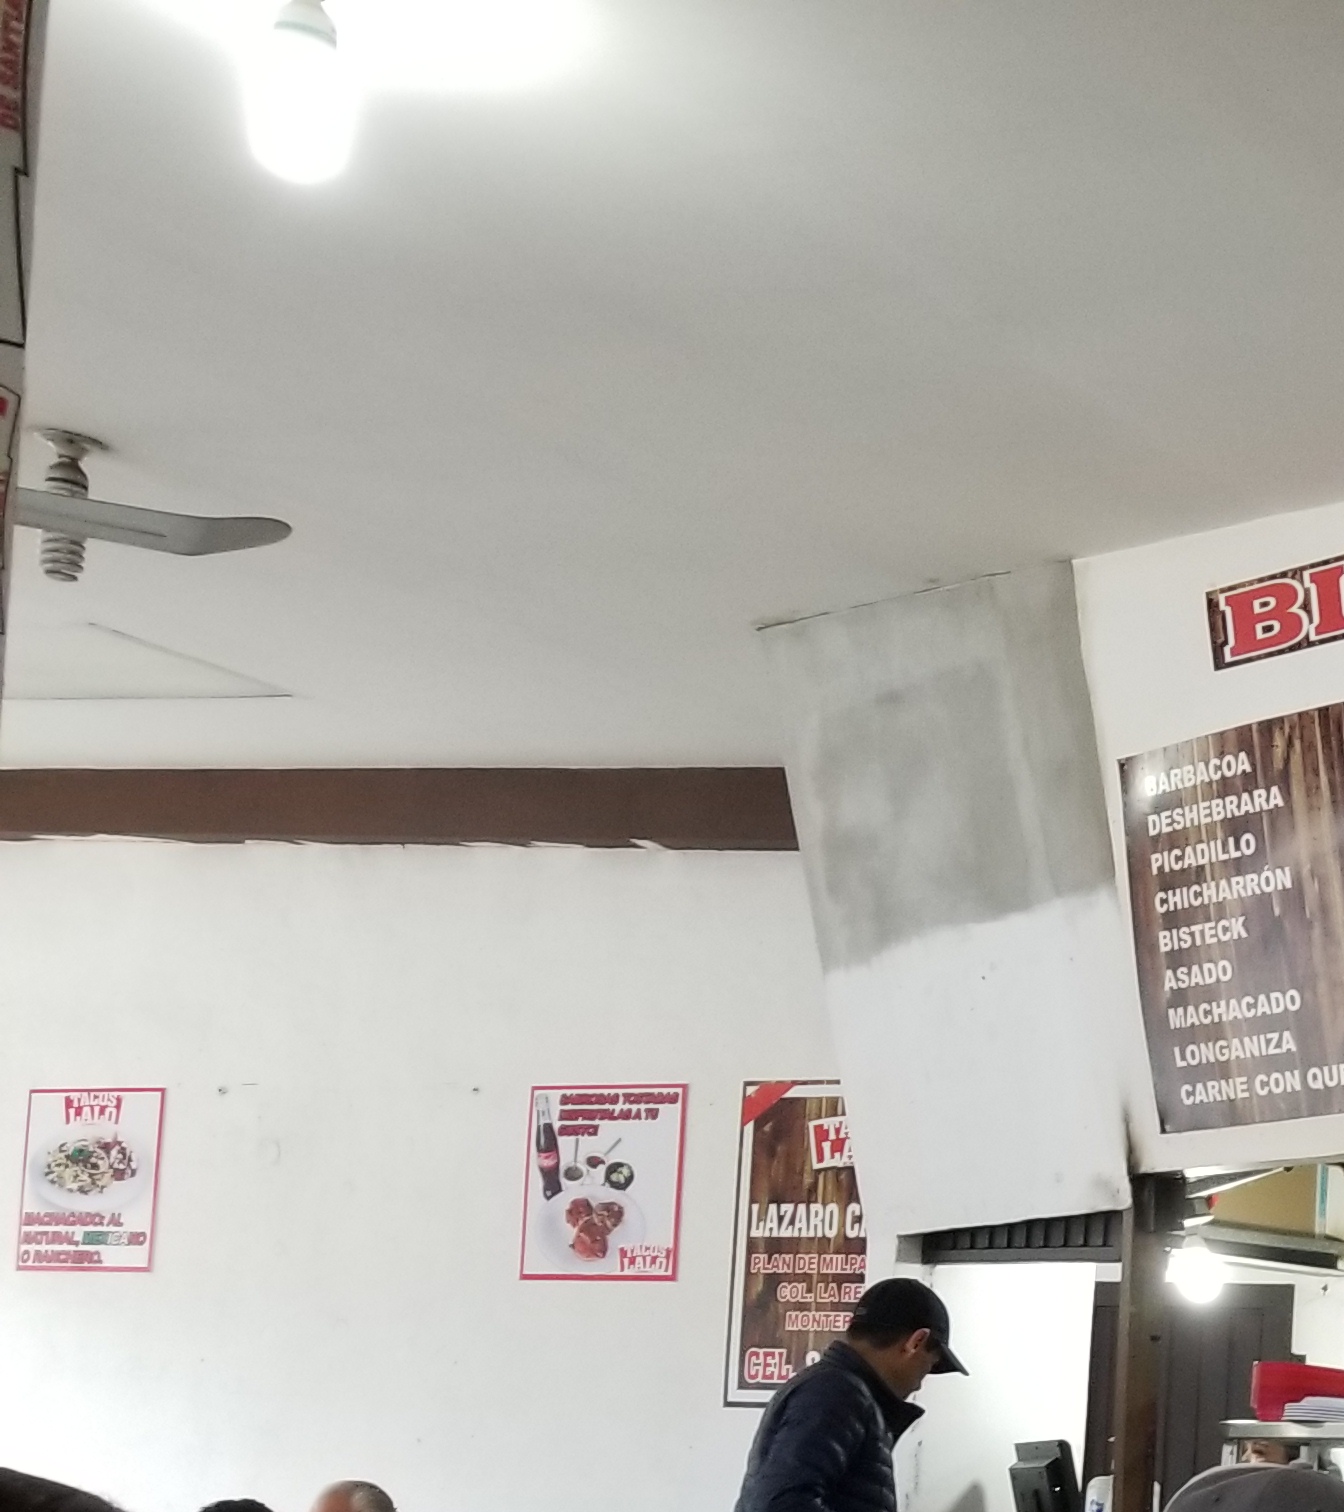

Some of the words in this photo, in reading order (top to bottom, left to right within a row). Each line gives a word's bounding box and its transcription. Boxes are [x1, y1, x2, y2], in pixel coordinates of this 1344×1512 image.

[1147, 786, 1284, 836] DESHEBRARA
[1150, 832, 1256, 875] PICADILLO
[1155, 865, 1292, 913] CHICHARRÓN
[1159, 916, 1248, 952] BISTECK
[1164, 960, 1232, 991] ASADO
[1168, 989, 1301, 1029] MACHACADO
[1174, 1031, 1296, 1067] LONGANIZA
[69, 1092, 118, 1107] TACOS
[1180, 1076, 1249, 1105] CARNE
[1255, 1070, 1301, 1096] CON
[750, 1202, 839, 1238] LAZARO
[750, 1254, 793, 1273] PLAN
[795, 1254, 818, 1274] DE
[777, 1282, 814, 1302] COL.
[817, 1283, 839, 1303] LA
